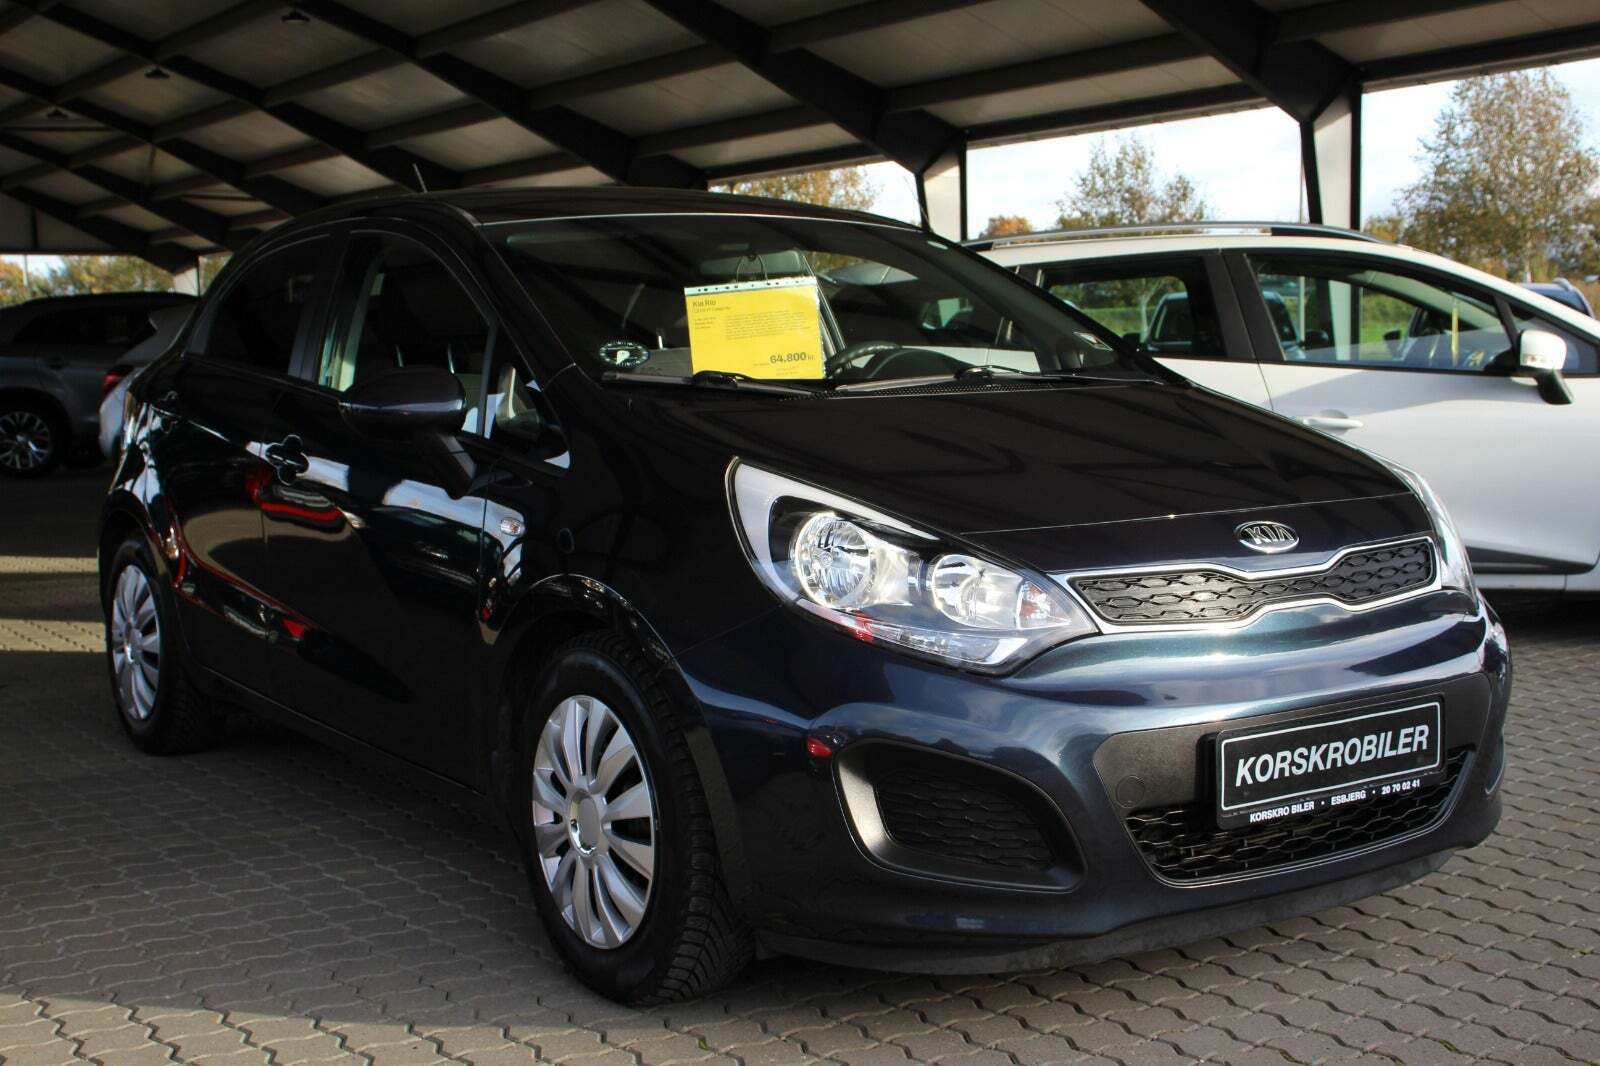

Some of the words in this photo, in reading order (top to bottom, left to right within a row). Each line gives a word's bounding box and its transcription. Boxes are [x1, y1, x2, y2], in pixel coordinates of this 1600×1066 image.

[769, 352, 807, 364] 64.800
[1244, 525, 1294, 544] KIA
[1235, 724, 1429, 787] KORSKROBILER
[1249, 807, 1289, 822] KORSKRO
[1291, 801, 1314, 813] BILER
[1331, 790, 1366, 805] ESBJERG
[1381, 785, 1391, 795] 20
[1392, 783, 1401, 792] 70
[1411, 778, 1421, 788] 41
